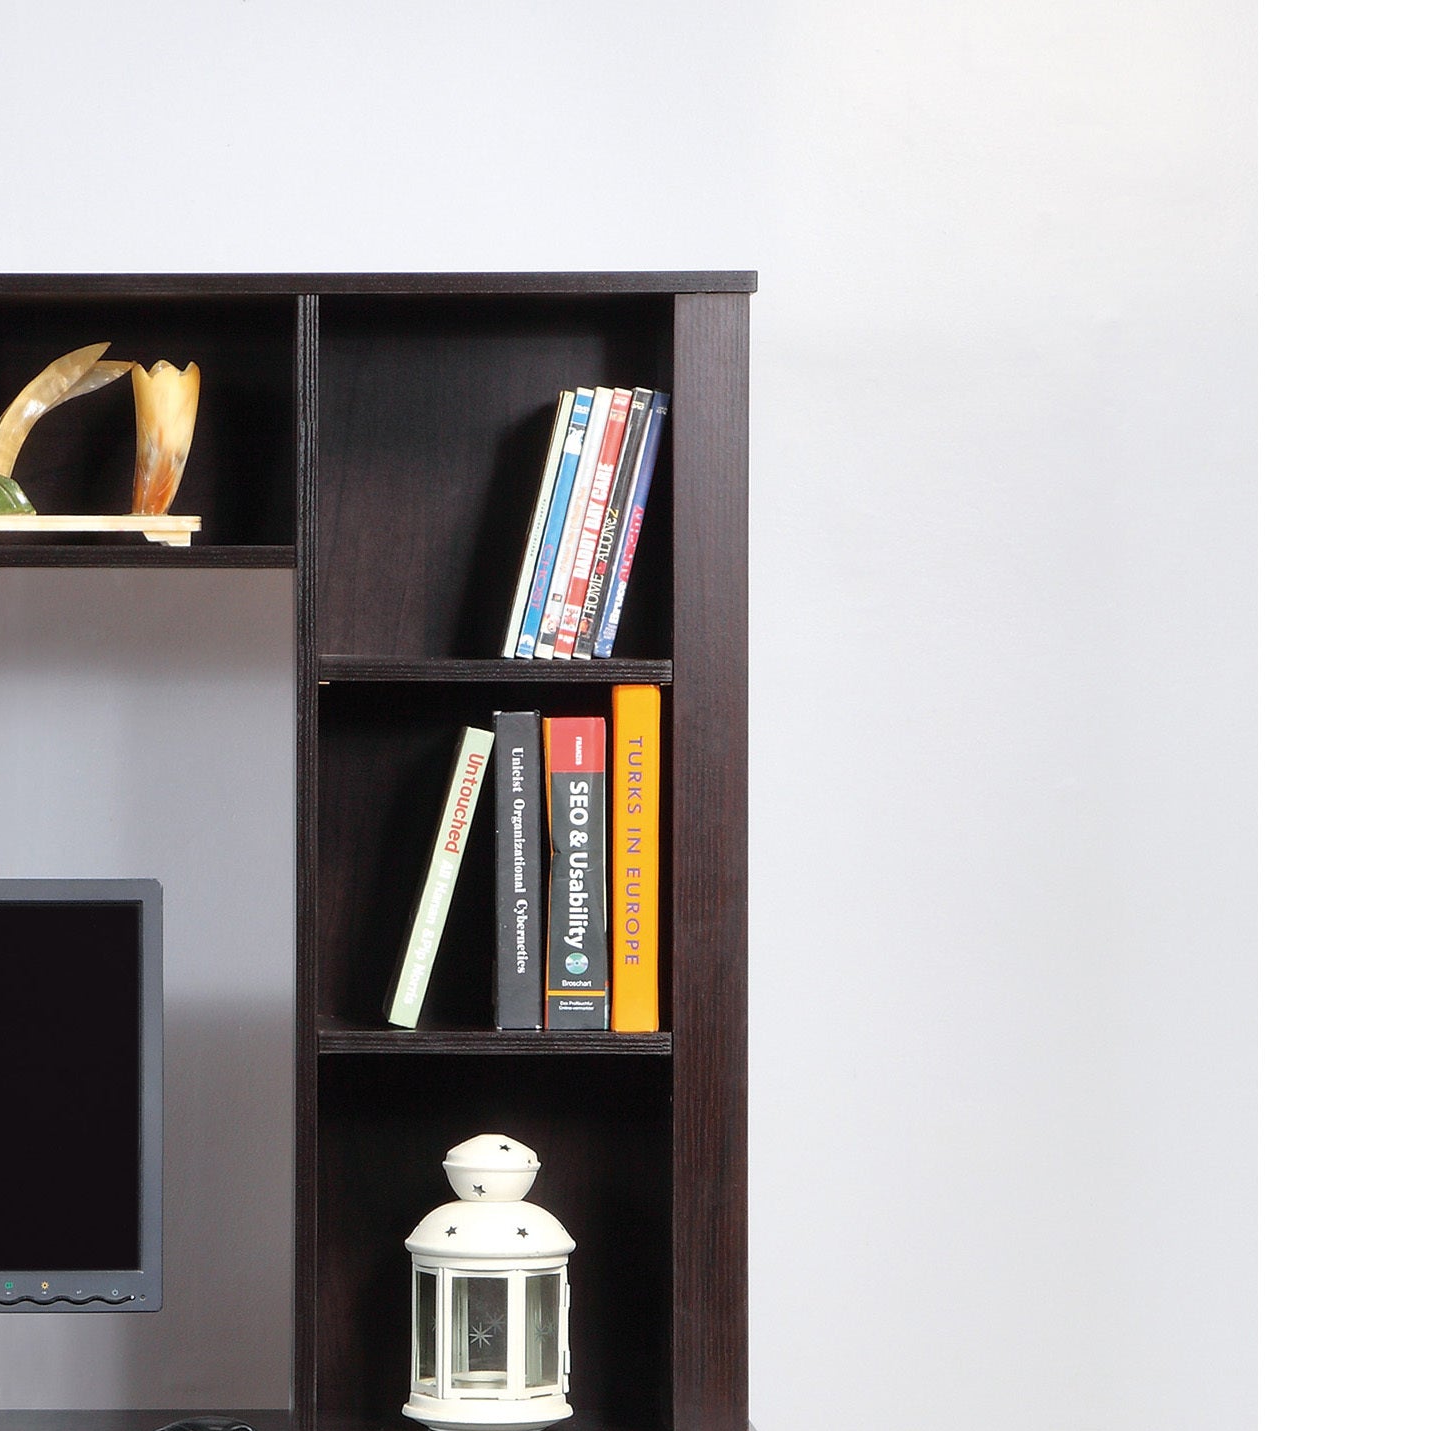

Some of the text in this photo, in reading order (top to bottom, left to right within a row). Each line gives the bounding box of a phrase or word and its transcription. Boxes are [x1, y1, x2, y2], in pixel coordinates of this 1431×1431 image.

[444, 753, 485, 854] Untouched
[511, 747, 529, 974] Unicist Organizational Cybernetics
[564, 781, 589, 949] SEO & Usability
[625, 736, 642, 965] TURKS IN EUROPE
